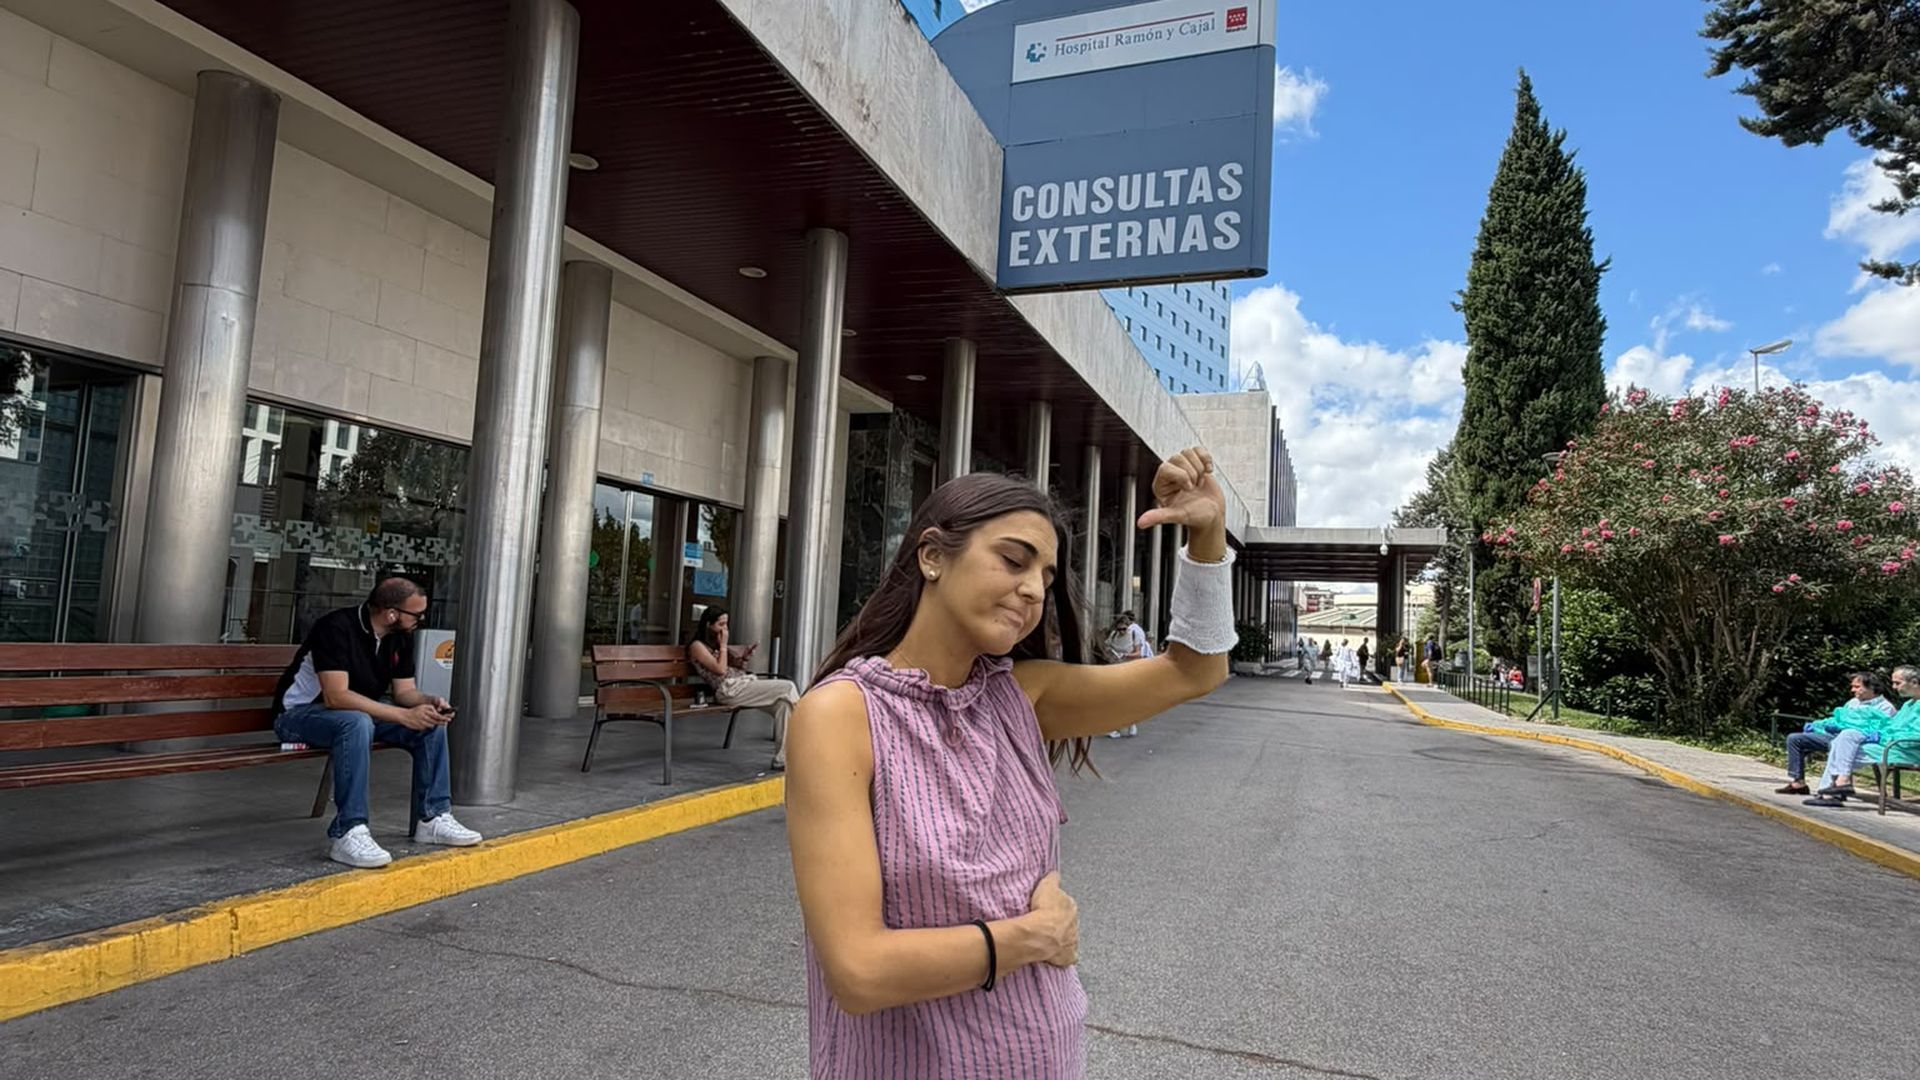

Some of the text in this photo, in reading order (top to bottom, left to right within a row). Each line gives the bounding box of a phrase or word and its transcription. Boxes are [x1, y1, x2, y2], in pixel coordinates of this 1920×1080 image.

[1055, 18, 1216, 56] Hospital Ramón y Cajal
[1012, 162, 1244, 222] CONSULTAS
[1009, 211, 1241, 267] EXTERNAS
